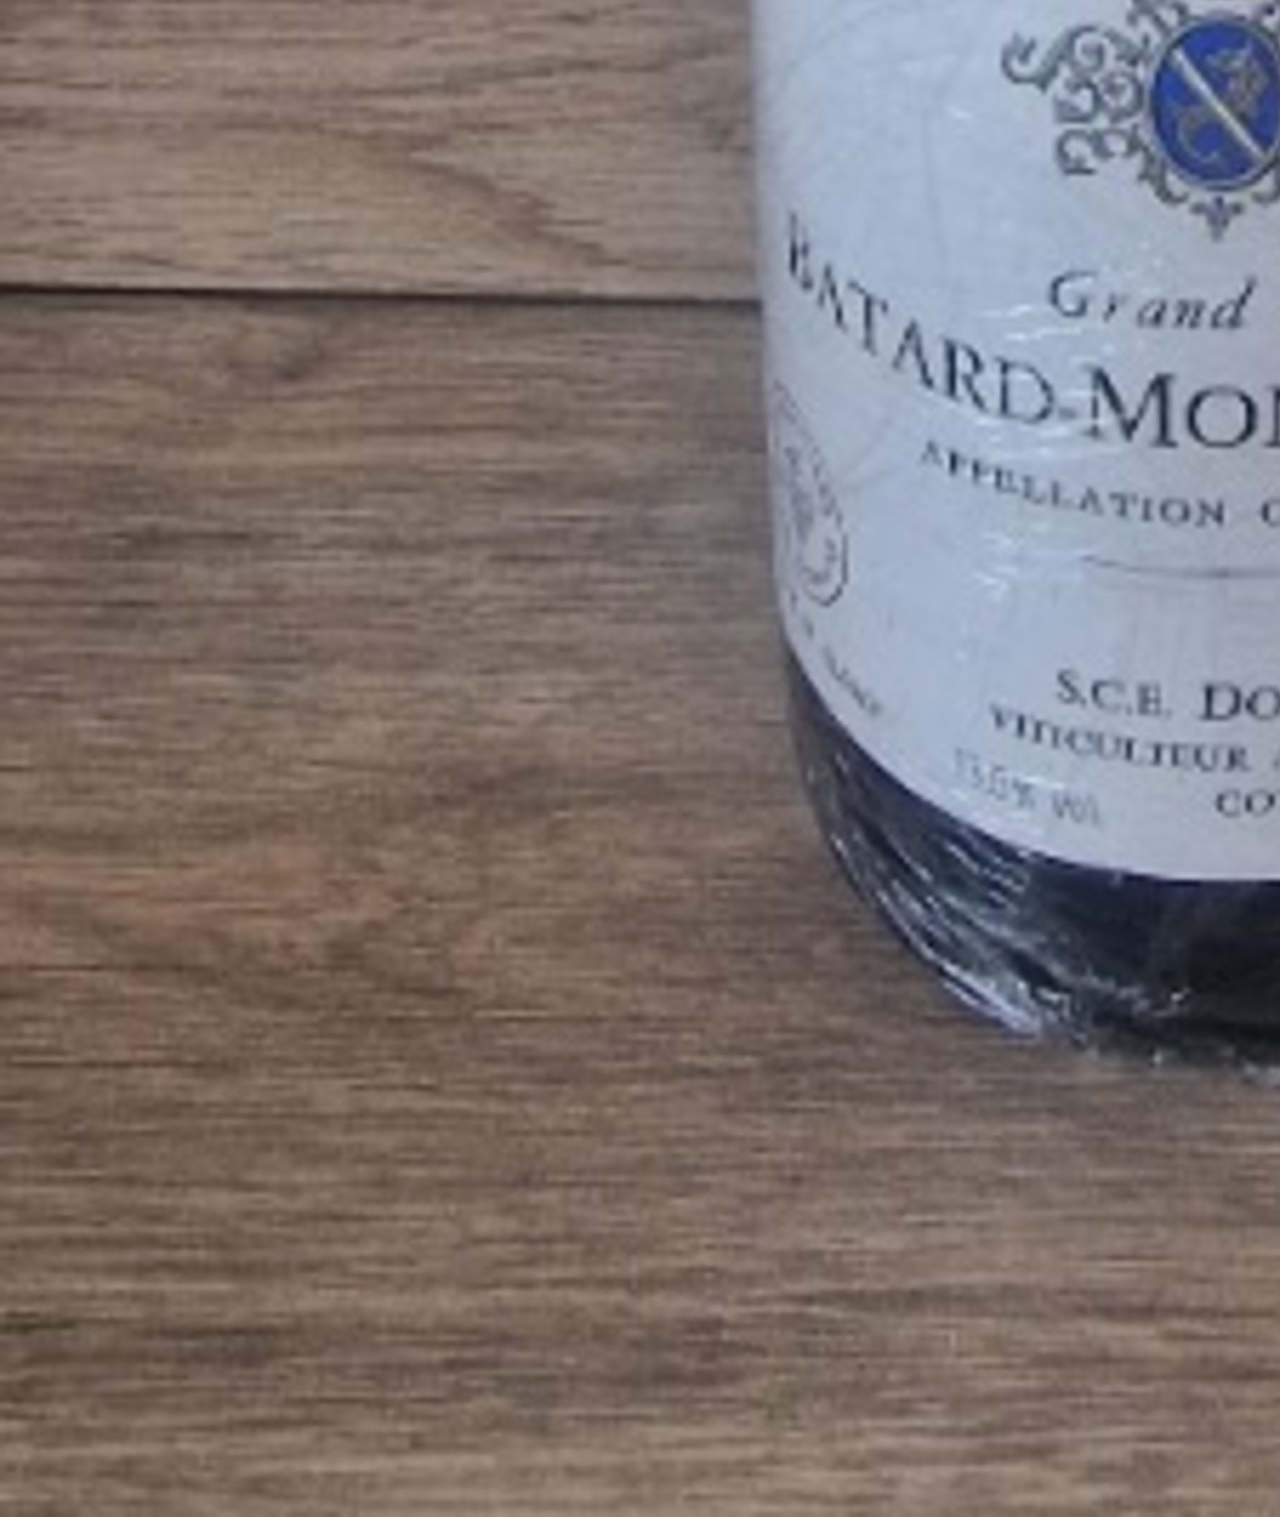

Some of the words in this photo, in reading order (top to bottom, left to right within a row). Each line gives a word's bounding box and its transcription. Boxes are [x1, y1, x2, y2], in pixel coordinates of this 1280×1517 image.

[1048, 268, 1257, 330] Grand
[920, 440, 1226, 527] APPELLATION
[1056, 668, 1173, 718] S.C.E.
[990, 702, 1252, 772] VITICULTEUR
